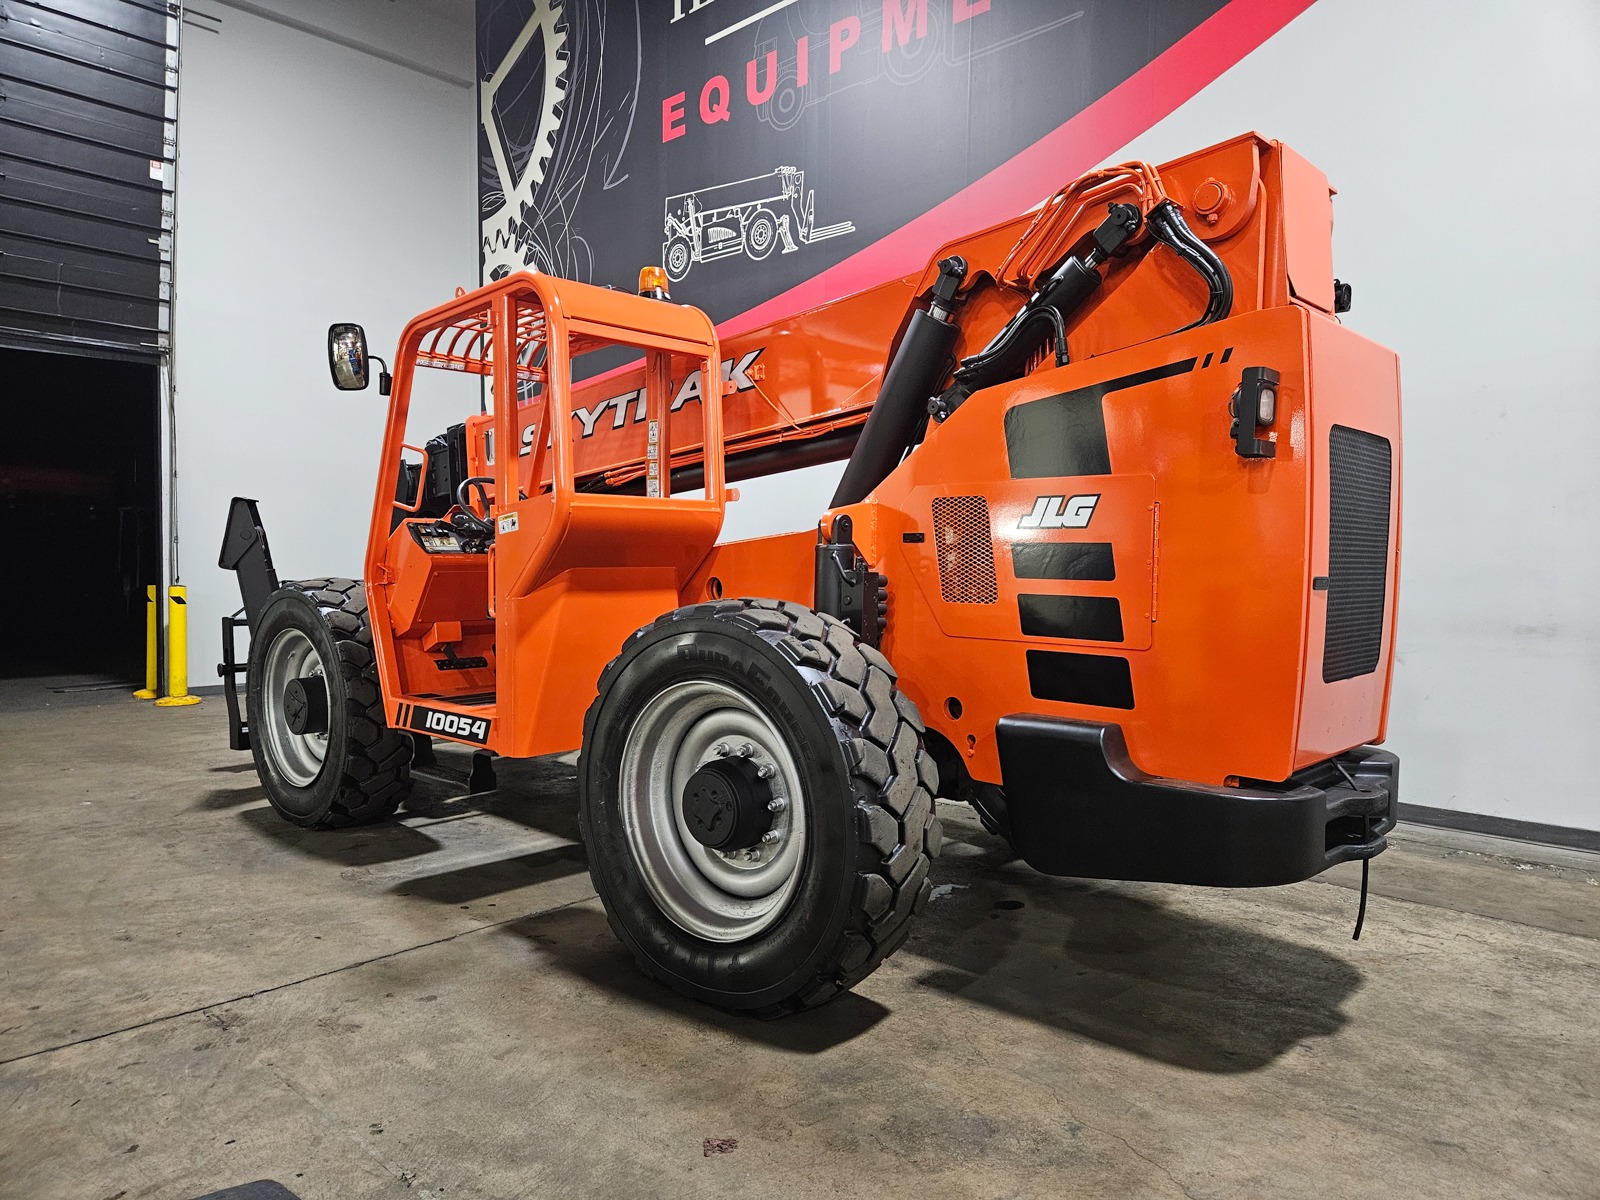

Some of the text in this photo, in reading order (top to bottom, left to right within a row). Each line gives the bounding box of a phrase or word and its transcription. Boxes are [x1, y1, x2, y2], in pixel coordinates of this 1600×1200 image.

[519, 347, 767, 457] SYTAK
[1017, 493, 1101, 529] JLG
[425, 711, 487, 740] 10054
